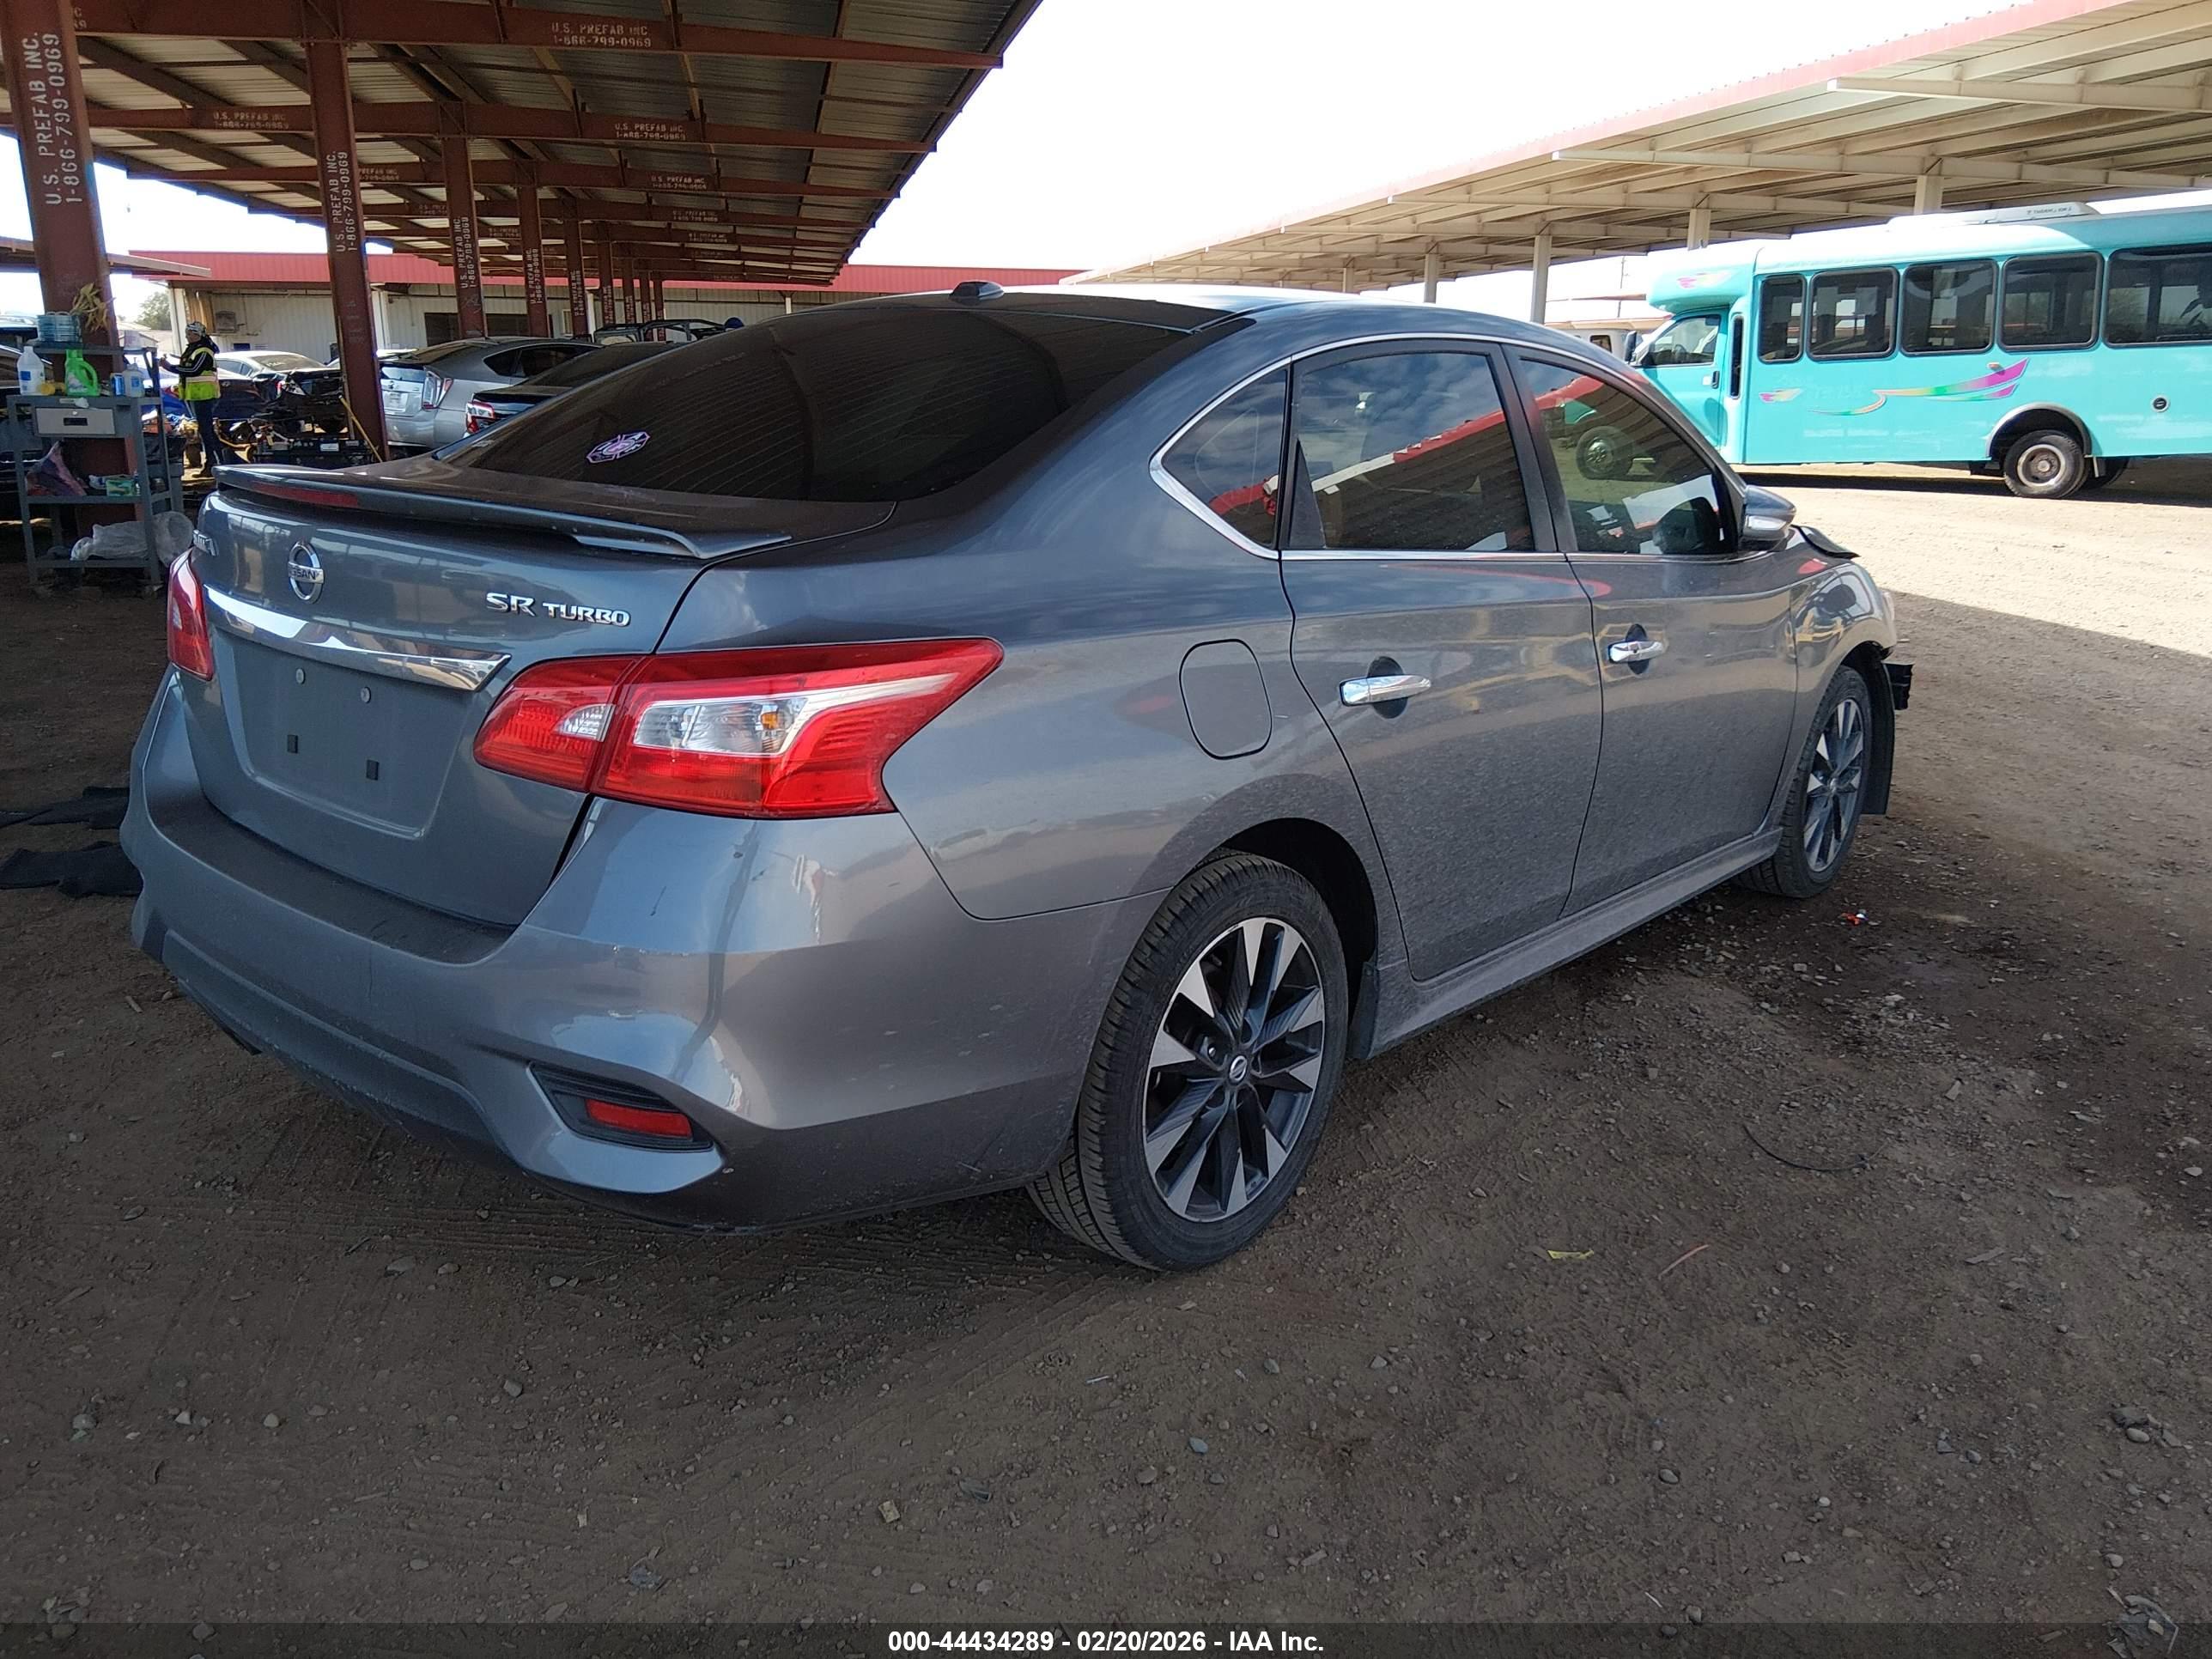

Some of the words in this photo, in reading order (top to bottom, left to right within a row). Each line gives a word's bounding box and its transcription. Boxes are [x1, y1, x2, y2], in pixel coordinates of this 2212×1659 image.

[580, 24, 624, 35] PREFAB
[22, 32, 43, 69] INC.
[28, 80, 56, 156] PREFAB
[42, 33, 83, 204] 1-866-799-0969
[326, 150, 338, 173] INC.
[44, 169, 63, 204] U.S.
[329, 179, 343, 224] PREFAB
[337, 151, 358, 251] 1-866-799-0969
[335, 229, 347, 252] U.S.
[485, 592, 537, 617] SR
[542, 601, 631, 628] TURBO
